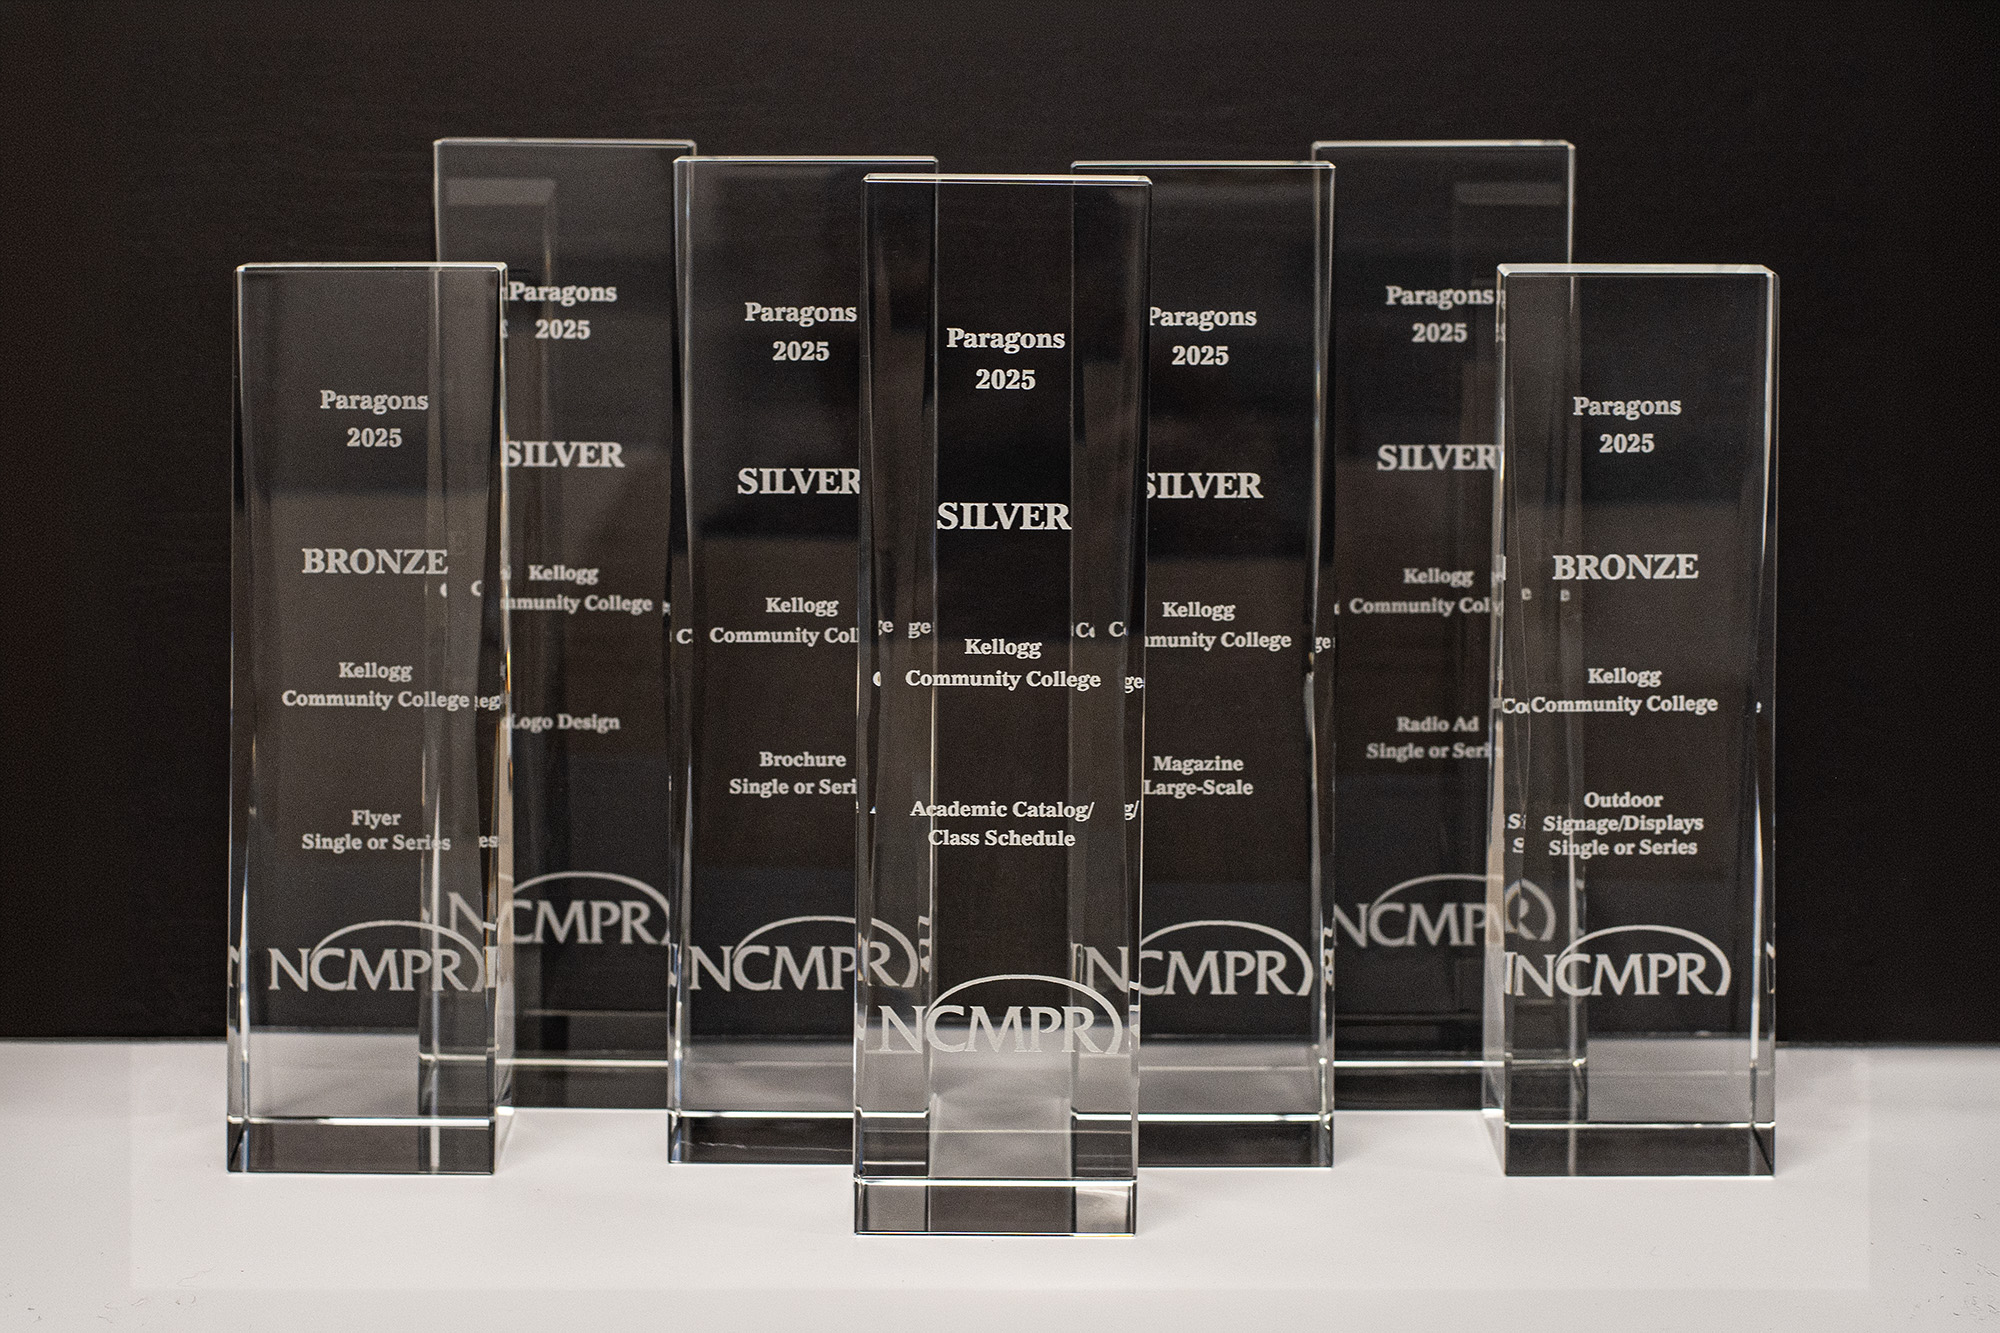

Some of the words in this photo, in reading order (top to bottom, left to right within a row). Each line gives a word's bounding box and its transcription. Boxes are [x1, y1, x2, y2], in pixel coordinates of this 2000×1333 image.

[508, 281, 617, 307] Paragons
[1386, 285, 1493, 310] Paragons
[745, 301, 858, 327] Paragons
[1150, 306, 1258, 331] Paragons
[535, 318, 591, 339] 2025
[1411, 322, 1468, 343] 2025
[772, 340, 830, 361] 2025
[946, 328, 1065, 354] Paragons
[1172, 345, 1229, 366] 2025
[974, 368, 1037, 391] 2025
[320, 390, 429, 415] Paragons
[1572, 396, 1683, 421] Paragons
[346, 427, 404, 448] 2025
[1598, 433, 1656, 454] 2025
[504, 441, 625, 468] SILVER
[1377, 444, 1497, 470] SILVER
[737, 468, 860, 495] SILVER
[936, 502, 1072, 530] SILVER
[301, 548, 448, 575] BRONZE
[1552, 554, 1699, 580] BRONZE
[528, 565, 599, 585] Kellogg
[1403, 568, 1474, 588] Kellogg
[508, 594, 580, 614] munity
[584, 595, 653, 615] College
[765, 597, 839, 617] Kellogg
[1162, 602, 1236, 622] Kellogg
[1350, 597, 1455, 617] Community
[709, 627, 820, 647] Community
[824, 627, 858, 643] Coll
[1145, 631, 1217, 651] munity
[1220, 631, 1292, 651] College
[964, 639, 1042, 659] Kellogg
[338, 661, 413, 682] Kellogg
[905, 670, 1021, 691] Community
[1026, 670, 1101, 690] College
[1588, 667, 1662, 687] Kellogg
[281, 690, 392, 710] Community
[397, 690, 470, 711] College
[1531, 696, 1641, 716] Community
[1646, 696, 1719, 715] College
[511, 713, 553, 733] Logo
[557, 713, 620, 734] Design
[1396, 715, 1449, 732] Radio
[1453, 715, 1480, 732] Ad
[759, 751, 847, 767] Brochure
[1366, 742, 1424, 763] Single
[1428, 745, 1449, 758] or
[1452, 742, 1490, 758] Seri
[1152, 755, 1244, 775] Magazine
[729, 778, 789, 798] Single
[793, 781, 815, 794] or
[818, 778, 857, 794] Seri
[1143, 779, 1254, 799] Large-Scale
[1584, 792, 1664, 808] Outdoor
[351, 810, 402, 829] Flyer
[910, 801, 1008, 818] Academic
[1012, 801, 1095, 822] Catalog/
[1543, 814, 1704, 836] Signage/Displays
[301, 833, 362, 853] Single
[367, 837, 389, 850] or
[393, 834, 451, 850] Series
[928, 829, 980, 846] Class
[984, 829, 1076, 847] Schedule
[1549, 839, 1608, 859] Single
[1614, 842, 1635, 855] or
[1639, 839, 1698, 855] Series
[268, 948, 470, 991] NCMPR
[688, 945, 900, 992] NCMPR
[1084, 946, 1297, 996] NCMPR
[1514, 952, 1716, 997] NCMPR
[878, 1005, 1104, 1055] NCMPR
